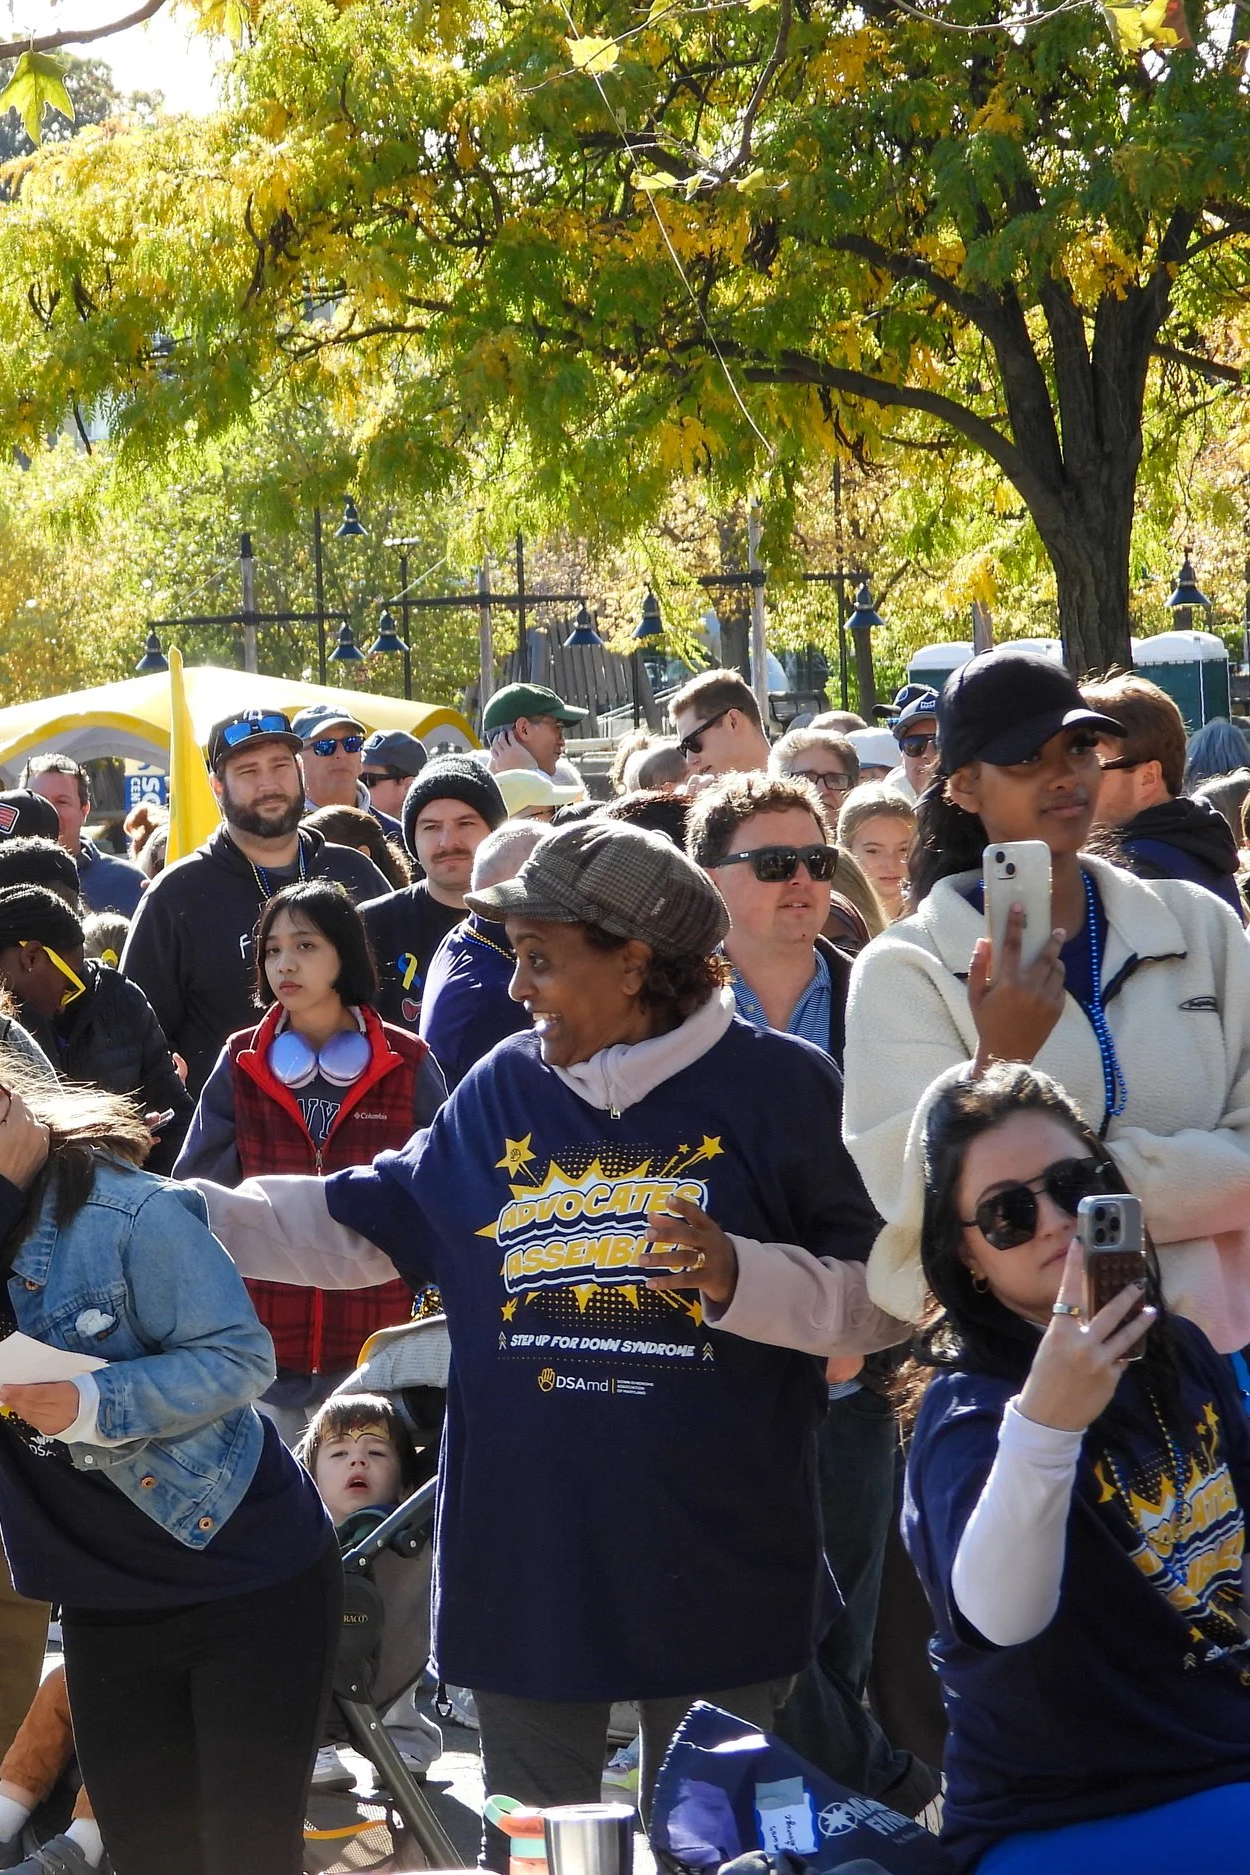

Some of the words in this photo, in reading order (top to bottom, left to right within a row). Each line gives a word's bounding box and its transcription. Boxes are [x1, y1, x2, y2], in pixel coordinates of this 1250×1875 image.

[361, 1112, 387, 1120] Columbia
[500, 1183, 703, 1234] ADVOCATES
[510, 1333, 535, 1347] STEP
[535, 1335, 550, 1347] UP
[550, 1335, 579, 1349] FOR
[579, 1337, 621, 1352] DOWN
[620, 1340, 696, 1357] SYNDROME
[556, 1376, 609, 1392] DSAmd
